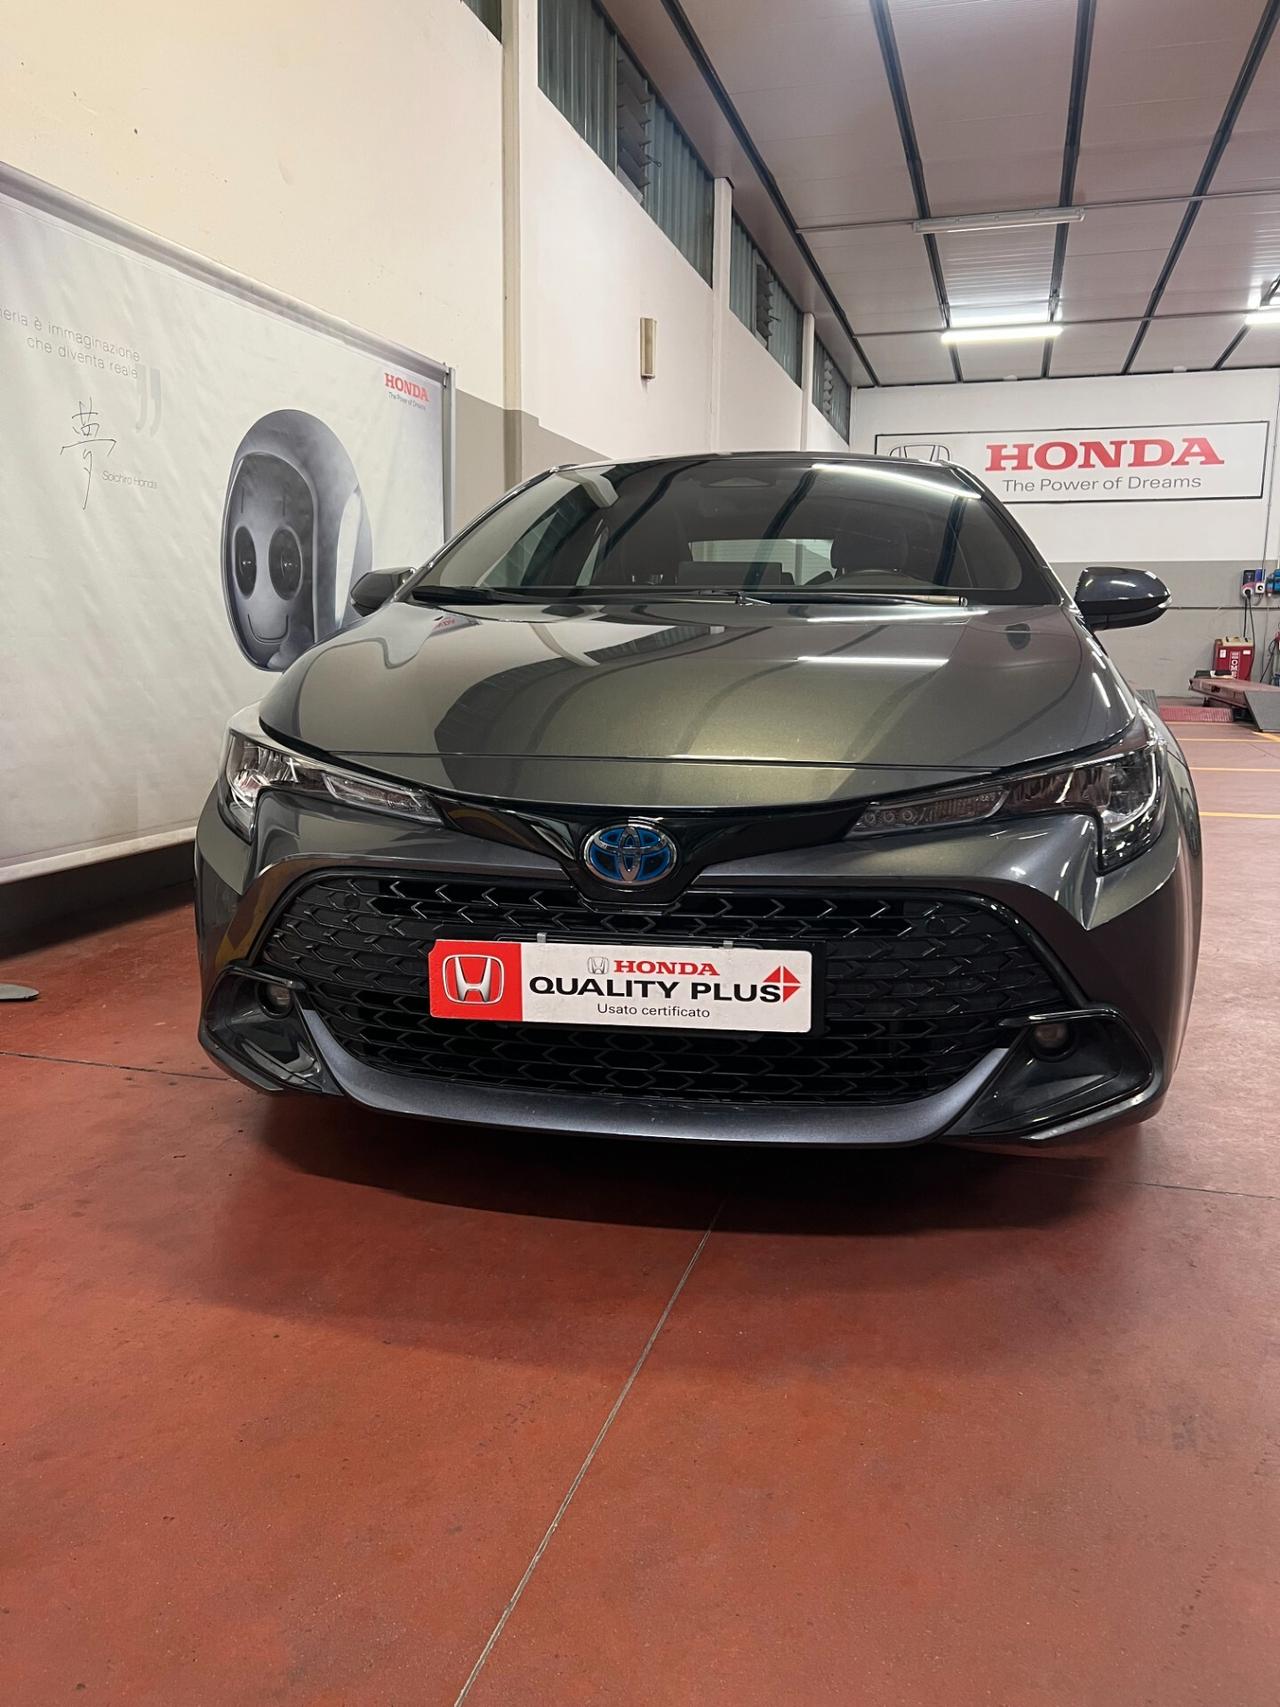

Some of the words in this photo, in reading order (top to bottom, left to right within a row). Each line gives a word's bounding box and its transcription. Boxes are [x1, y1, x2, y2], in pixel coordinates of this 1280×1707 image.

[34, 316, 42, 331] è
[48, 322, 140, 361] immaginazione
[27, 336, 52, 353] che
[58, 345, 104, 369] diventa
[109, 361, 138, 379] reale
[384, 372, 429, 402] HONDA
[985, 438, 1225, 471] HONDA
[1002, 480, 1035, 492] The
[1040, 478, 1098, 492] Power
[1103, 476, 1122, 490] of
[1128, 475, 1202, 489] Dreams
[613, 960, 720, 976] HONDA
[529, 976, 680, 999] QUALITY
[691, 982, 782, 1002] PLUS
[597, 1003, 637, 1016] Usato
[641, 1005, 711, 1018] certificato
